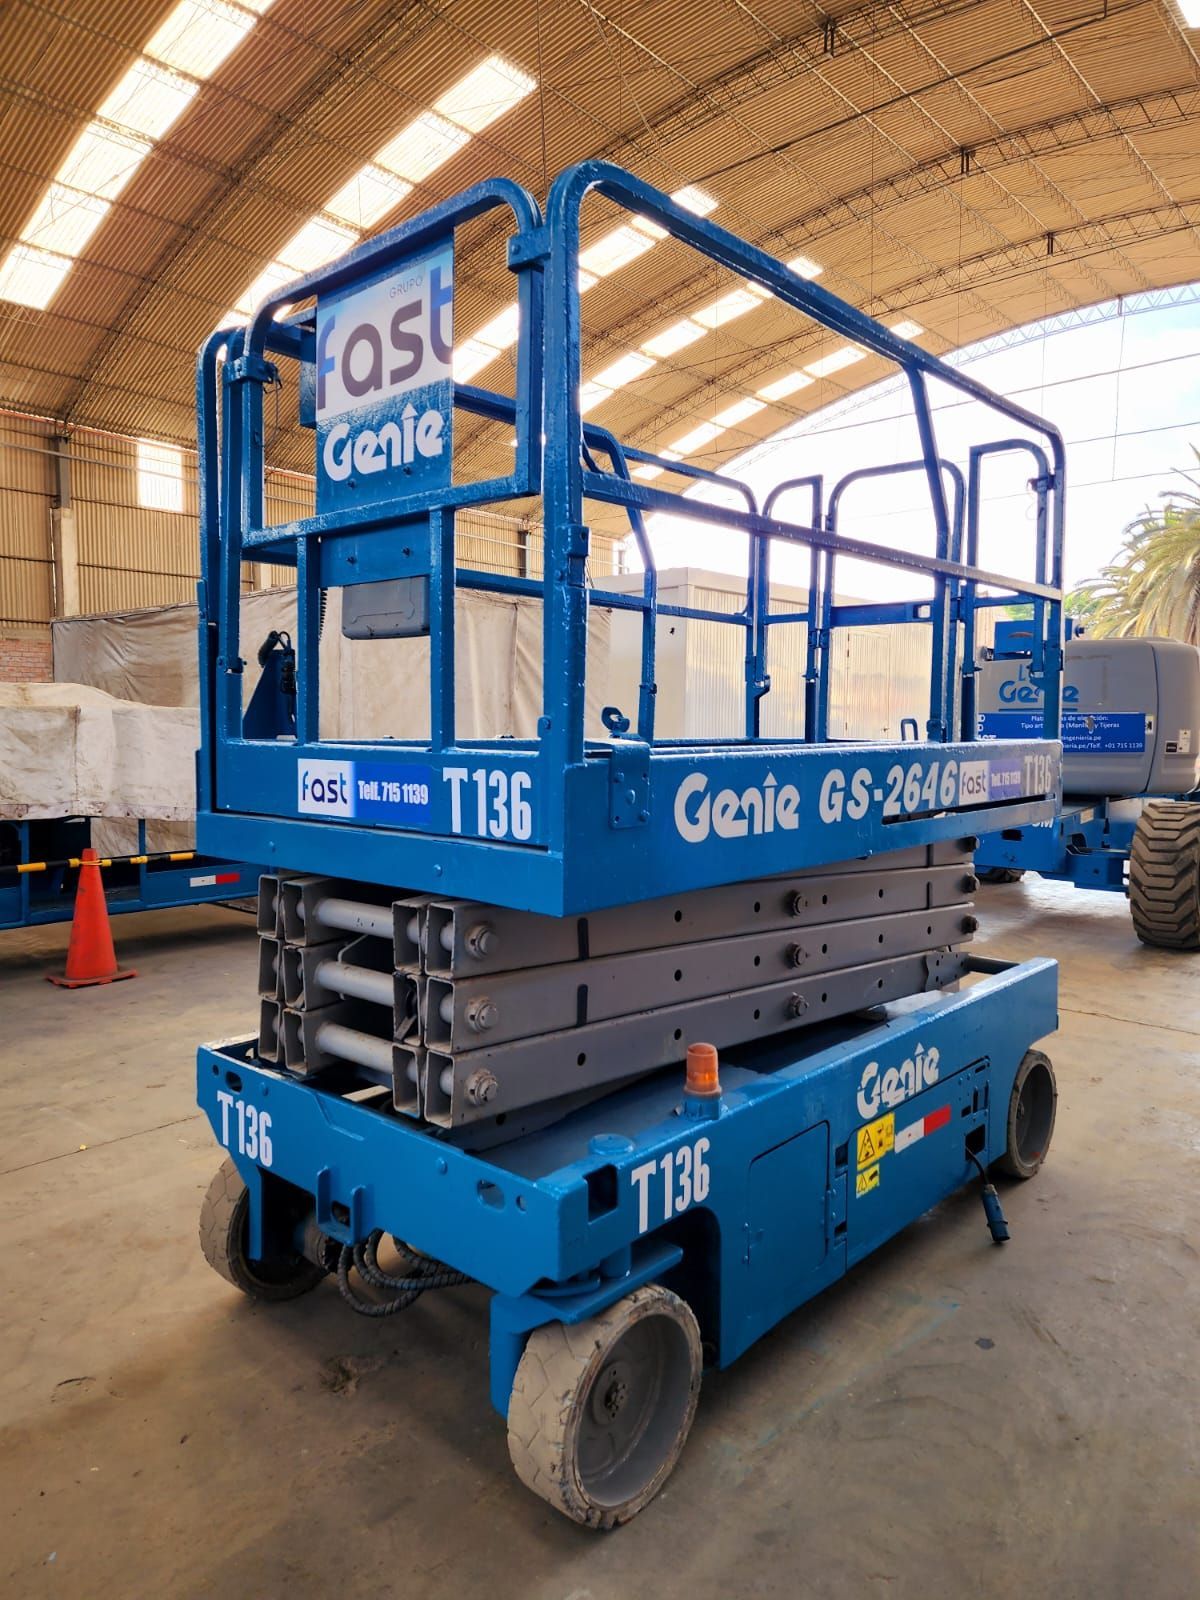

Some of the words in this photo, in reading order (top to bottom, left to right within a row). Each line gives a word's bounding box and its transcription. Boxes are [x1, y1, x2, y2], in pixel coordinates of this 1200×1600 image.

[389, 276, 424, 298] GRUPO
[317, 266, 453, 411] fast
[323, 402, 445, 482] Genie
[998, 681, 1080, 703] Gee
[302, 769, 348, 805] fast
[381, 781, 401, 803] 715
[402, 783, 429, 806] 1139
[442, 766, 532, 841] T136
[674, 771, 801, 844] Genie
[818, 760, 958, 824] GS-2646
[961, 769, 987, 796] fast
[1024, 755, 1052, 796] T136
[856, 1042, 940, 1119] Genie
[217, 1090, 273, 1167] T136
[631, 1137, 711, 1234] T136
